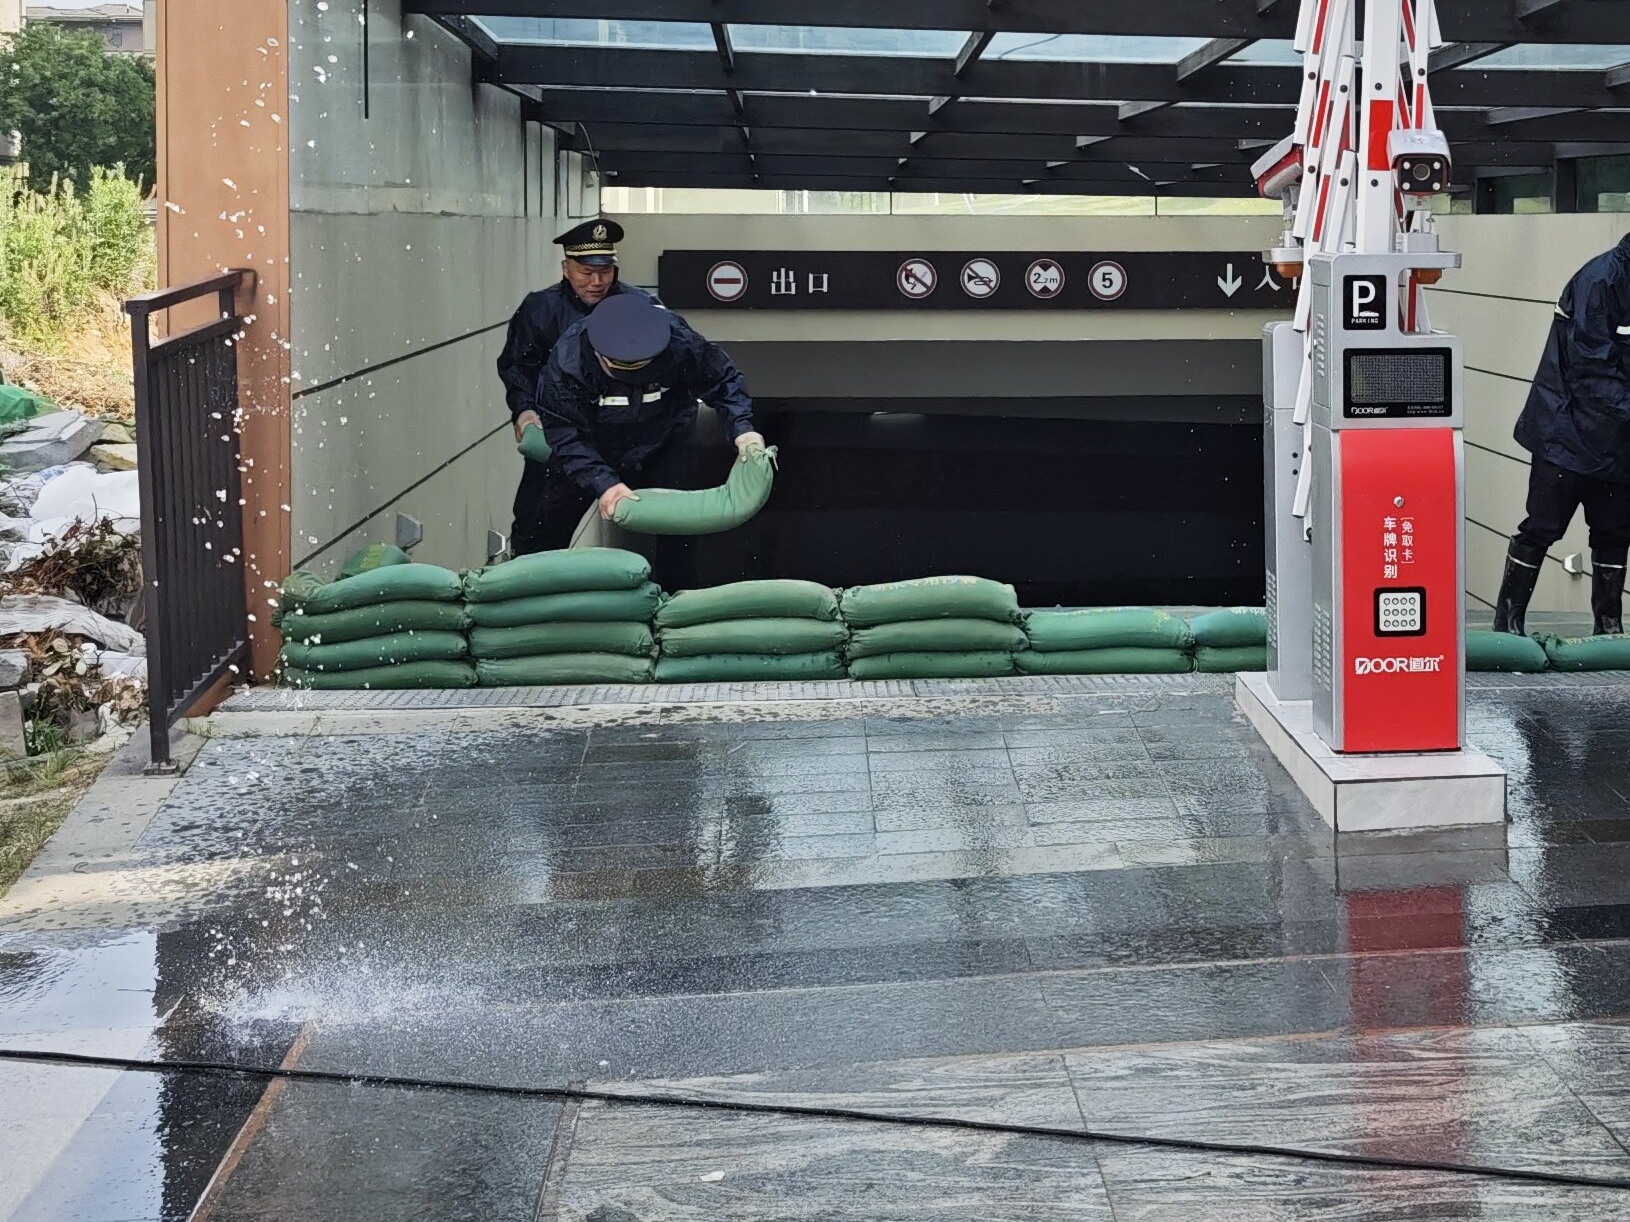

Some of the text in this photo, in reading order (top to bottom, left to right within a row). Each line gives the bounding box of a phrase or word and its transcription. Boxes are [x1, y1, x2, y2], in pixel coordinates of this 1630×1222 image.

[771, 267, 828, 295] 出口
[1101, 272, 1113, 289] 5
[1353, 281, 1375, 317] P
[1383, 516, 1397, 579] 车牌识别
